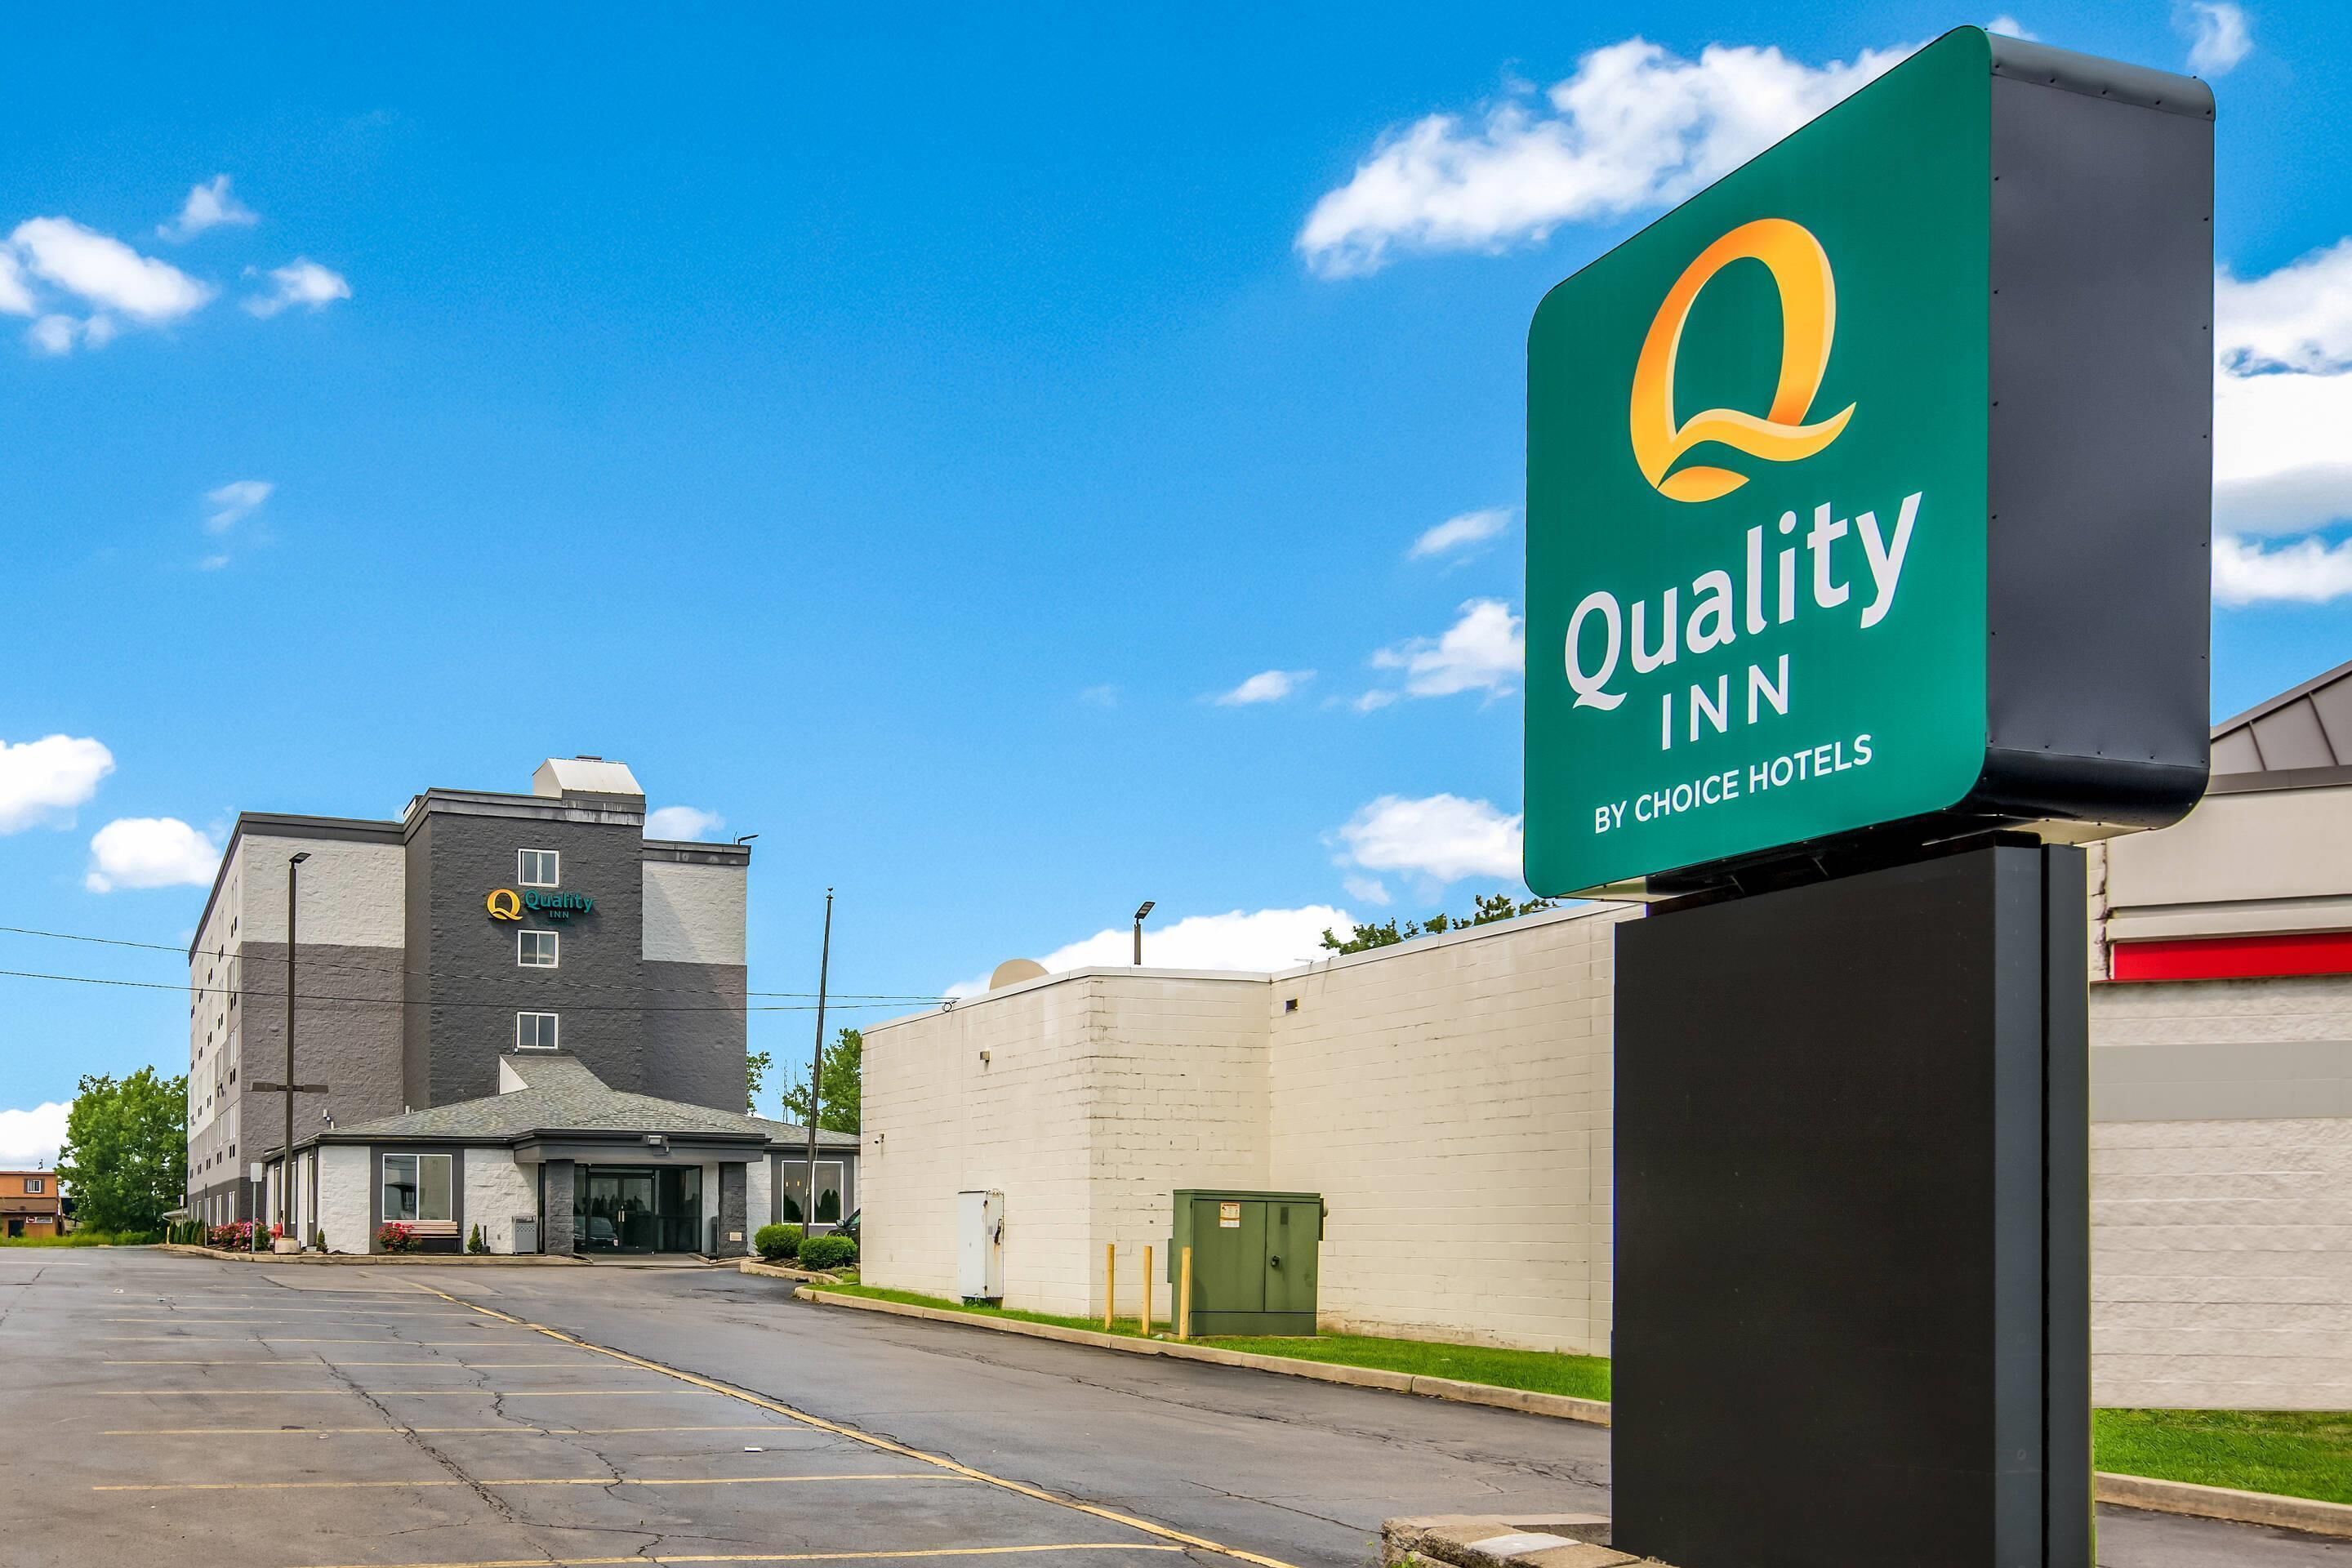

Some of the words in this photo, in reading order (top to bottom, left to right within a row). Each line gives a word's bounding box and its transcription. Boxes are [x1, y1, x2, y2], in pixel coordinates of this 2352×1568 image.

[1630, 218, 1855, 503] Q
[1565, 491, 1923, 711] Quality
[1662, 653, 1788, 751] INN
[1595, 800, 1628, 834] BY
[1635, 769, 1740, 822] CHOICE
[1749, 734, 1873, 794] HOTELS
[487, 889, 523, 920] Q
[524, 889, 594, 913] Quality
[550, 910, 569, 919] INN
